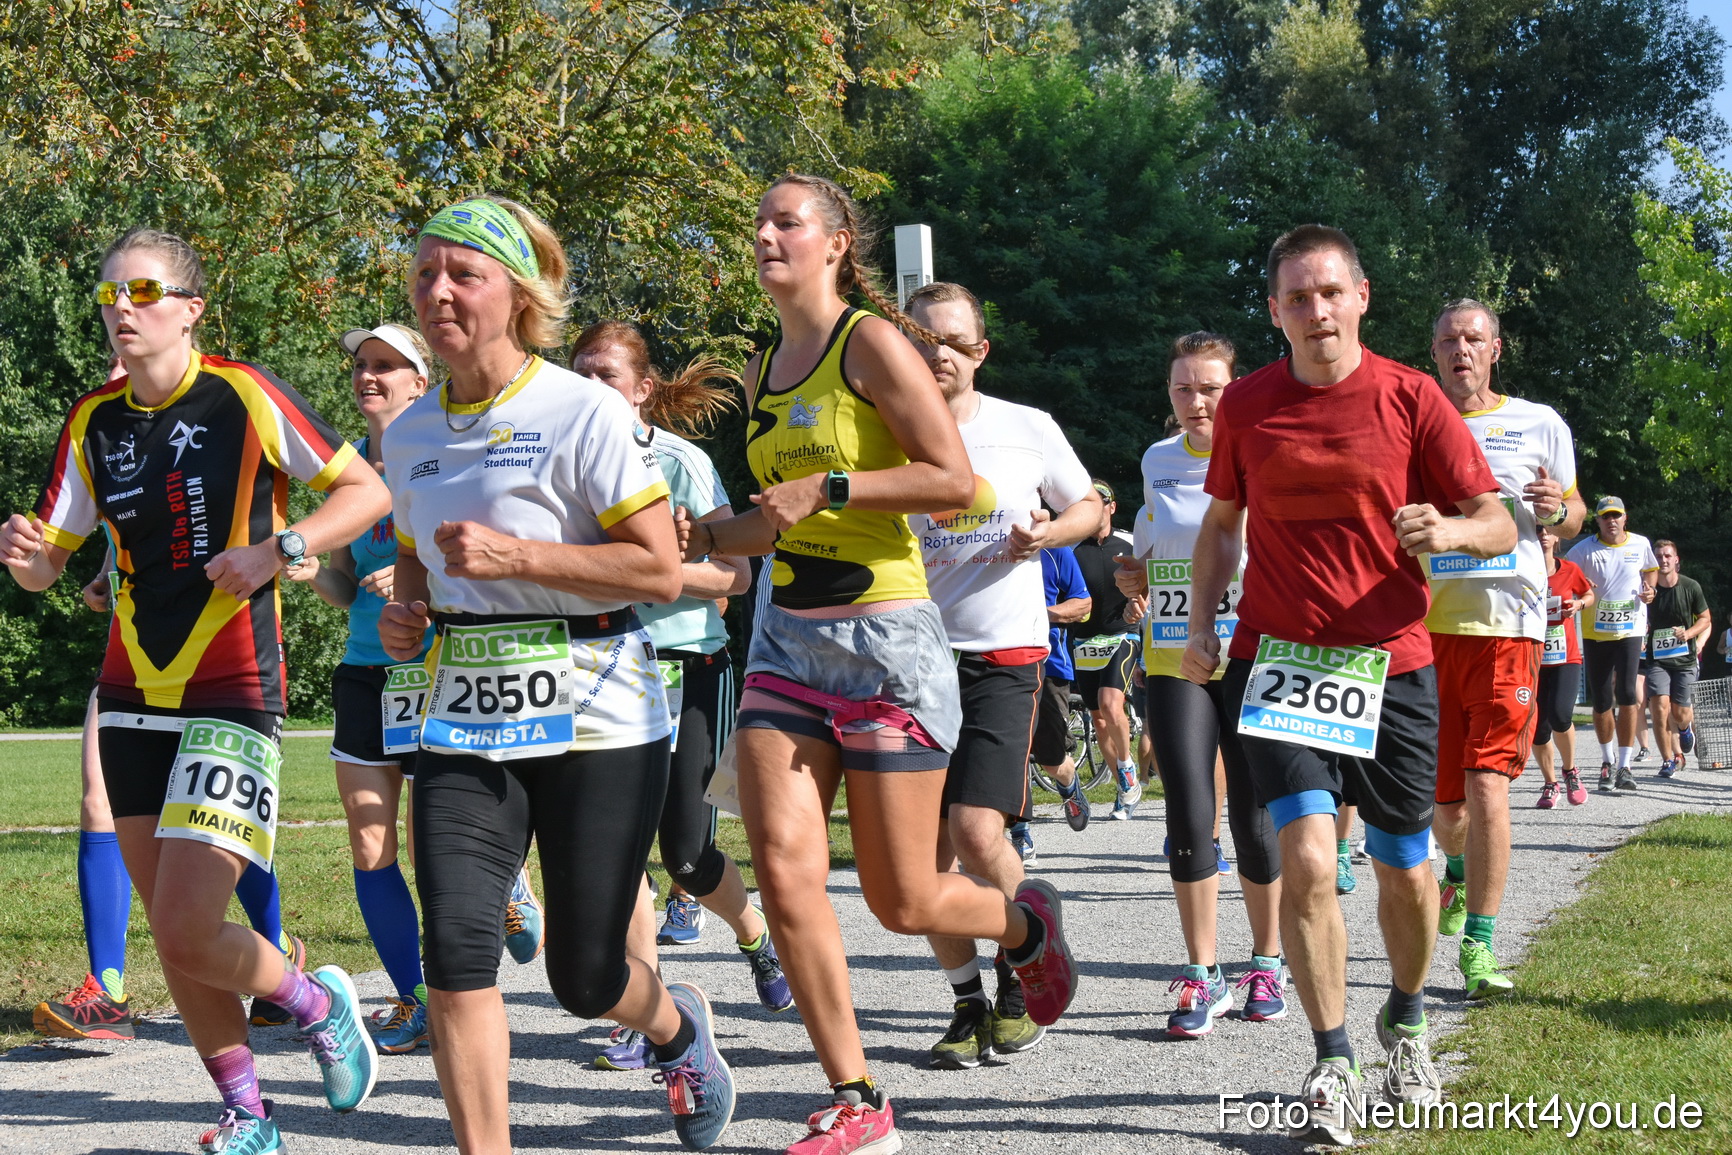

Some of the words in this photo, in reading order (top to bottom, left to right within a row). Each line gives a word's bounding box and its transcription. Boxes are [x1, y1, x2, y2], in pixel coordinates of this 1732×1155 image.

[486, 428, 512, 445] 20
[515, 433, 539, 441] JAHRE
[1486, 427, 1505, 437] 20
[486, 444, 547, 457] Neumarkter
[776, 443, 836, 464] Triathlon
[1485, 444, 1518, 453] Stadtlauf
[484, 457, 534, 469] Stadtlauf
[779, 455, 839, 472] HILPOLTSTEIN
[166, 470, 187, 513] ROTH
[116, 509, 138, 521] MAIKE
[186, 476, 209, 558] TRIATHLON
[926, 510, 1004, 531] Lauftreff
[924, 529, 1007, 550] Röttenbach
[170, 539, 190, 570] TSG
[941, 558, 958, 567] mit
[972, 554, 998, 564] bleib
[1437, 557, 1510, 570] CHRISTIAN
[1600, 611, 1630, 622] 2225
[451, 627, 557, 663] BOCK
[610, 640, 626, 661] 2019
[1080, 646, 1115, 657] 1358
[1266, 640, 1374, 680] BOCK
[447, 670, 557, 715] 2650
[1260, 669, 1366, 720] 2360
[449, 722, 548, 746] CHRISTA
[1259, 713, 1356, 743] ANDREAS
[188, 725, 280, 777] BOCK
[185, 761, 273, 822] 1096
[188, 809, 254, 843] MAIKE
